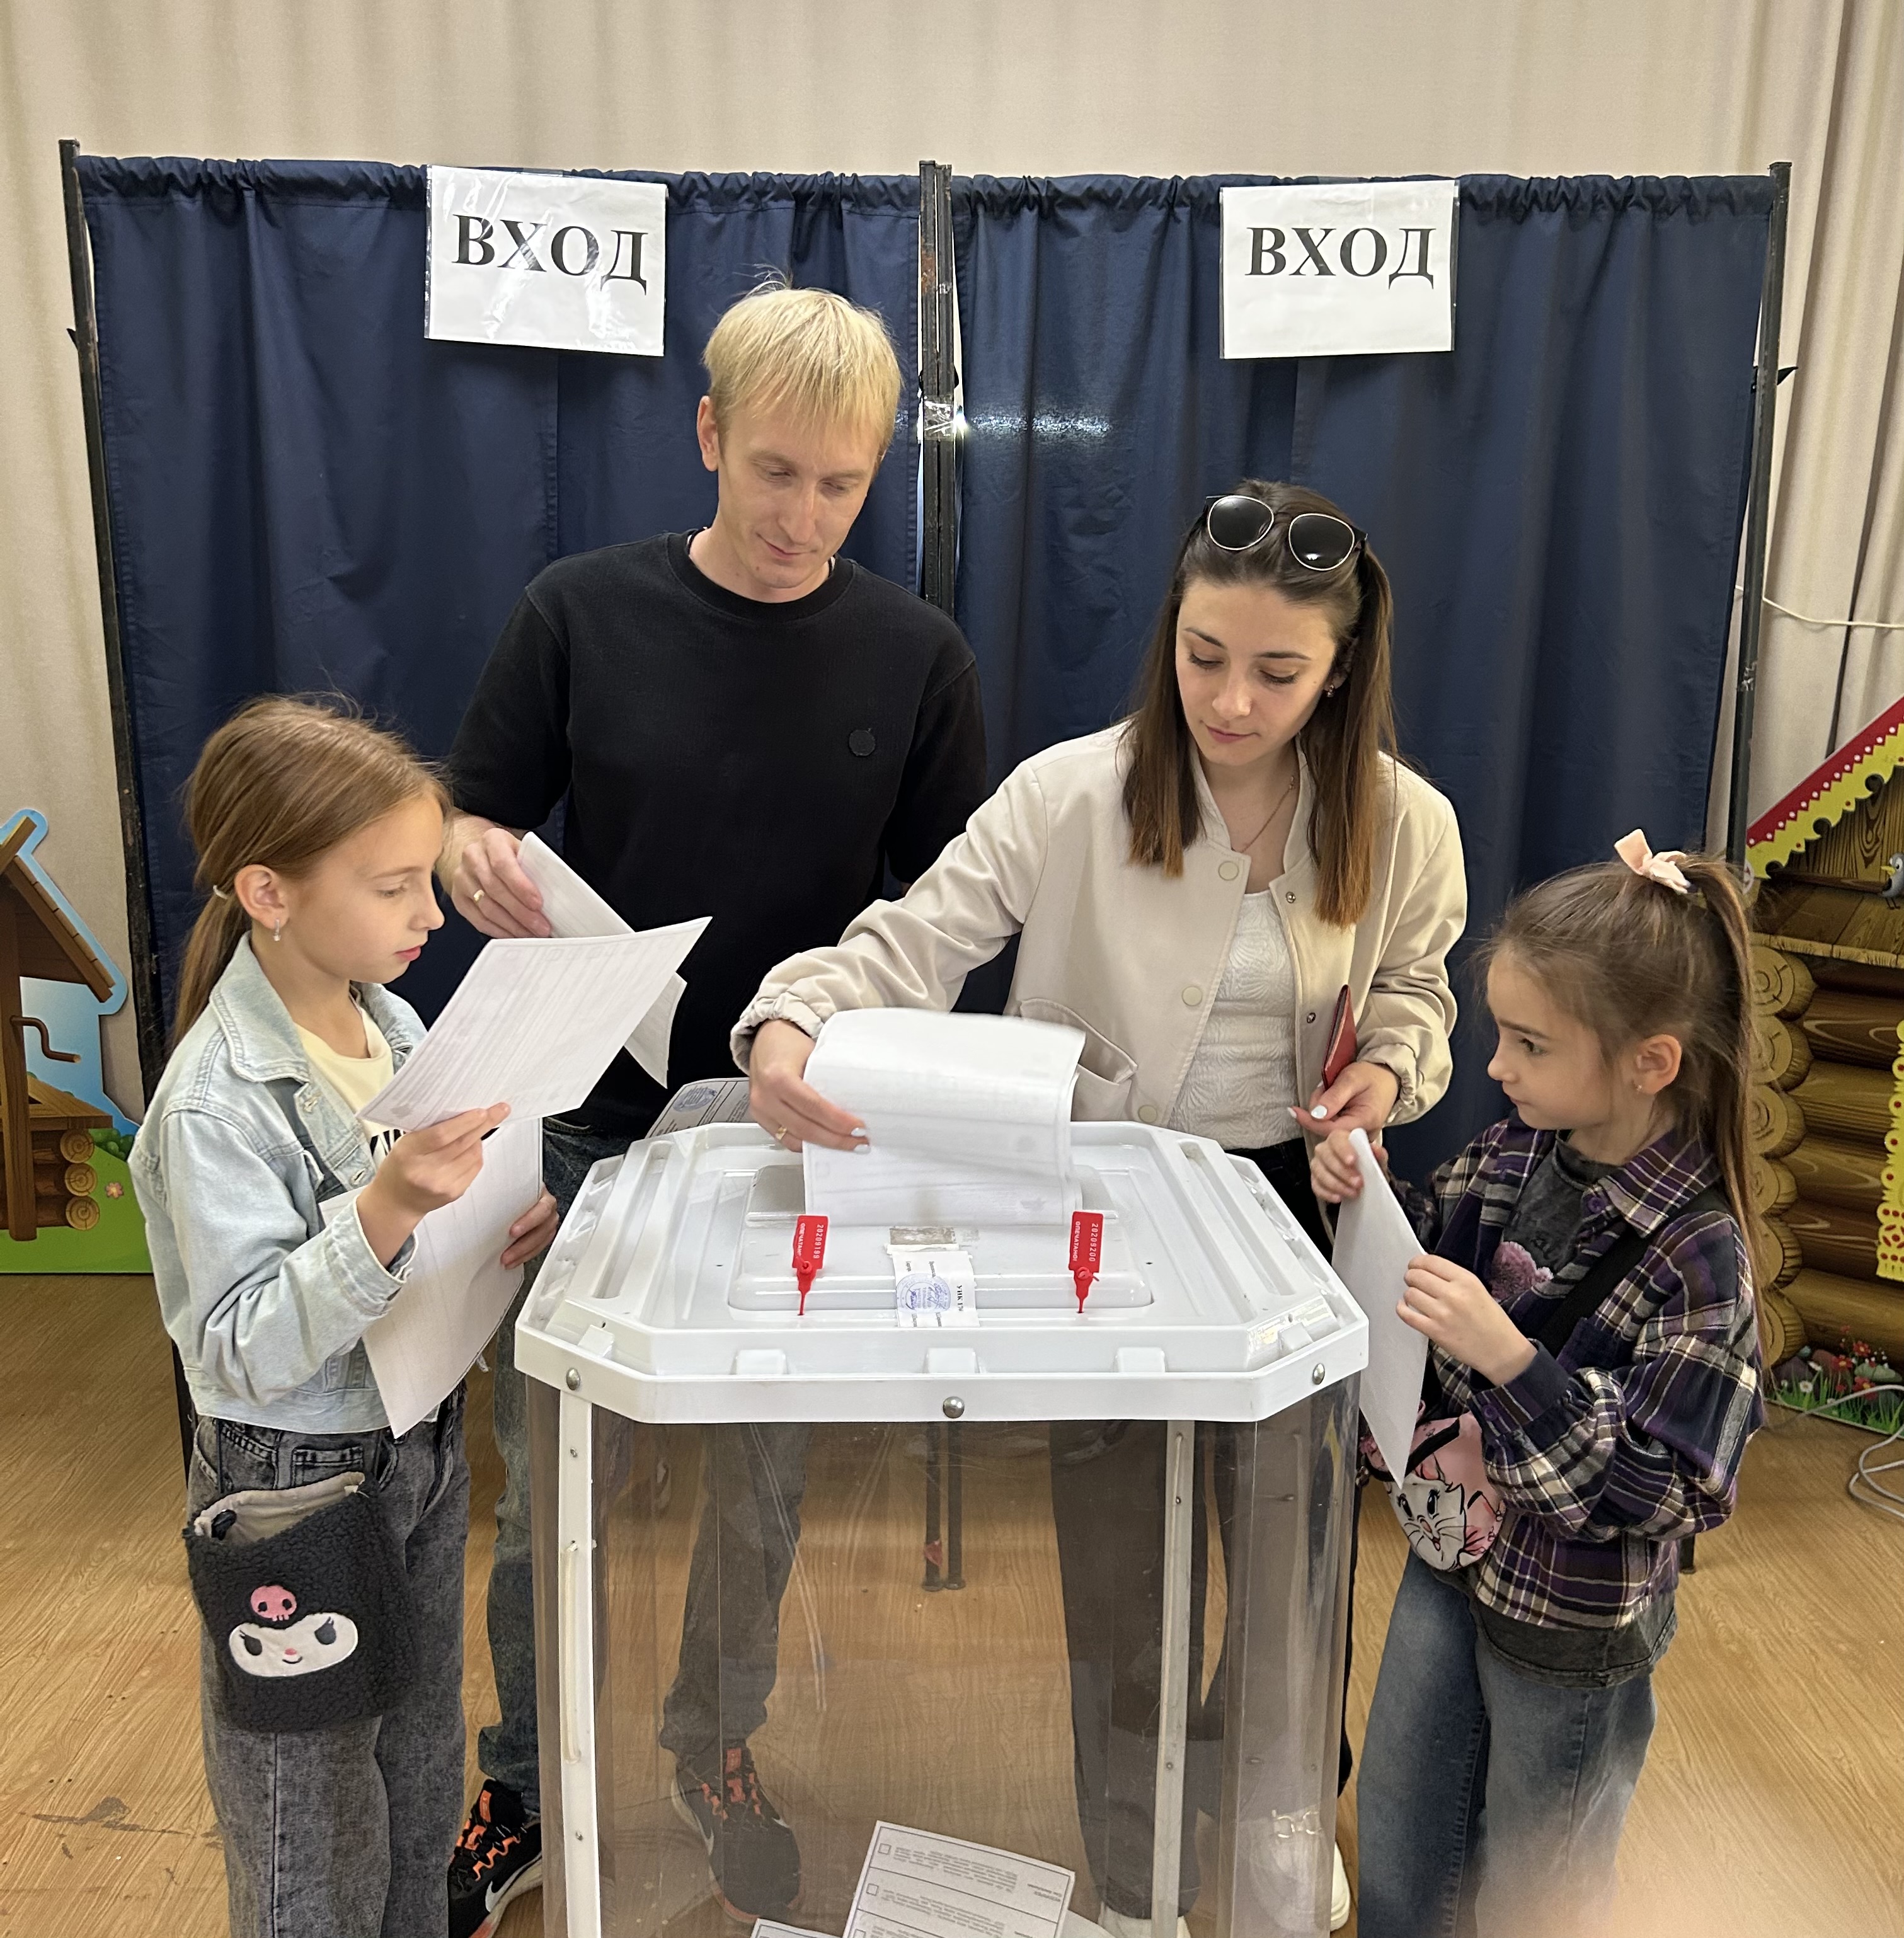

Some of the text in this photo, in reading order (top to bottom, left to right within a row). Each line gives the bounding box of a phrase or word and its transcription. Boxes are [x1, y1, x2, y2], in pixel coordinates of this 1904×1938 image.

[452, 214, 648, 295] ВХОД
[1245, 227, 1437, 290] ВХОД
[813, 1224, 824, 1259] 20209199
[1072, 1221, 1081, 1261] ОПЕЧАТАНО!
[1089, 1223, 1099, 1262] 20209200
